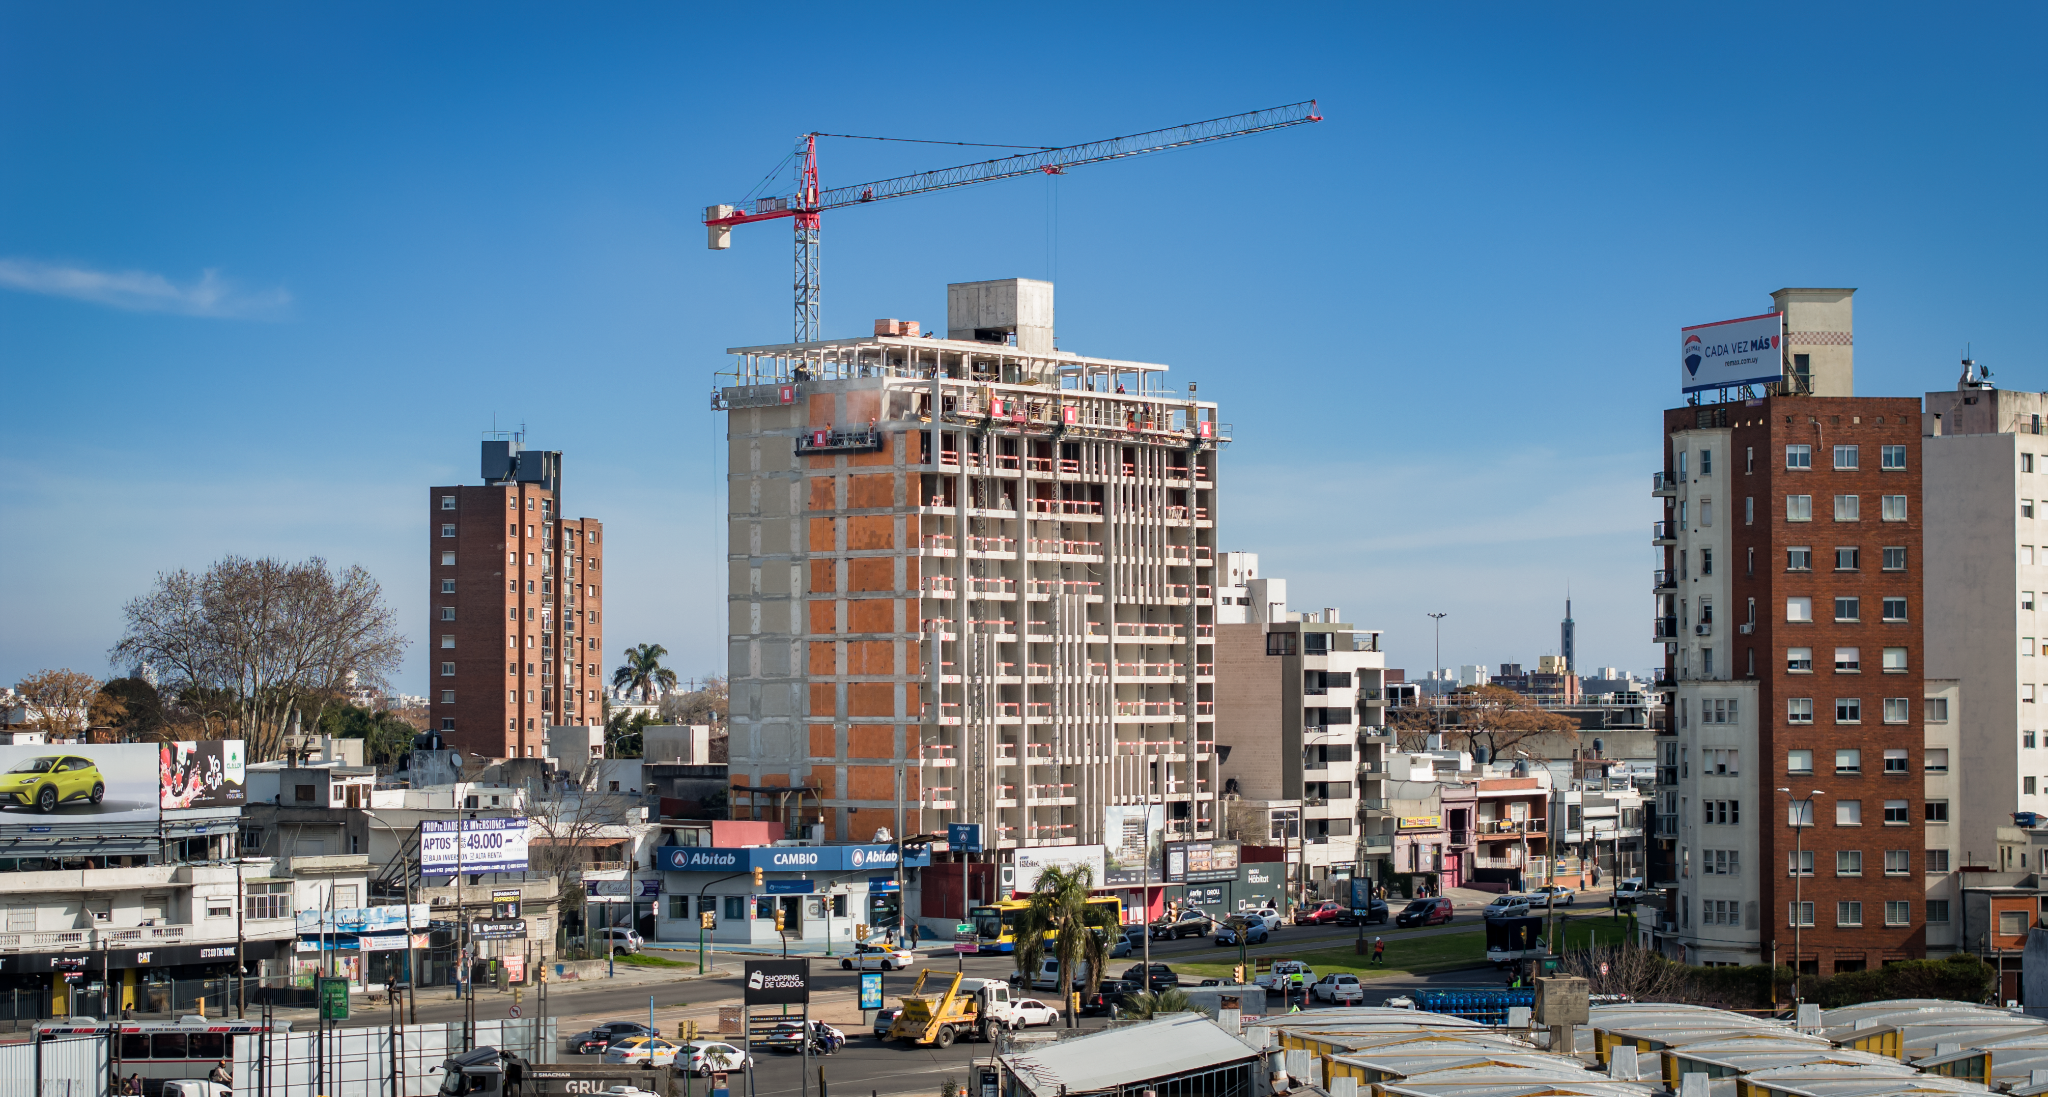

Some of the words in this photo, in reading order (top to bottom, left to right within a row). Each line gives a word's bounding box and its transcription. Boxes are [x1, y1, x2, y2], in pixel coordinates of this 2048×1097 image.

[1705, 344, 1729, 358] CADA
[1731, 341, 1748, 354] VEZ
[1750, 335, 1770, 351] MÁS
[1724, 357, 1758, 367] remax.com.uy
[422, 821, 462, 831] PROPIEDADE
[463, 821, 469, 830] &
[470, 819, 506, 830] INVERSIONES
[423, 837, 451, 851] APTOS
[467, 833, 503, 849] 49.000
[428, 854, 441, 862] BAJA
[690, 852, 736, 865] Abitab
[773, 853, 818, 865] CAMBIO
[865, 850, 898, 863] Abitab
[137, 952, 151, 964] CAT
[764, 974, 800, 982] SHOPPING
[775, 980, 805, 988] USADOS
